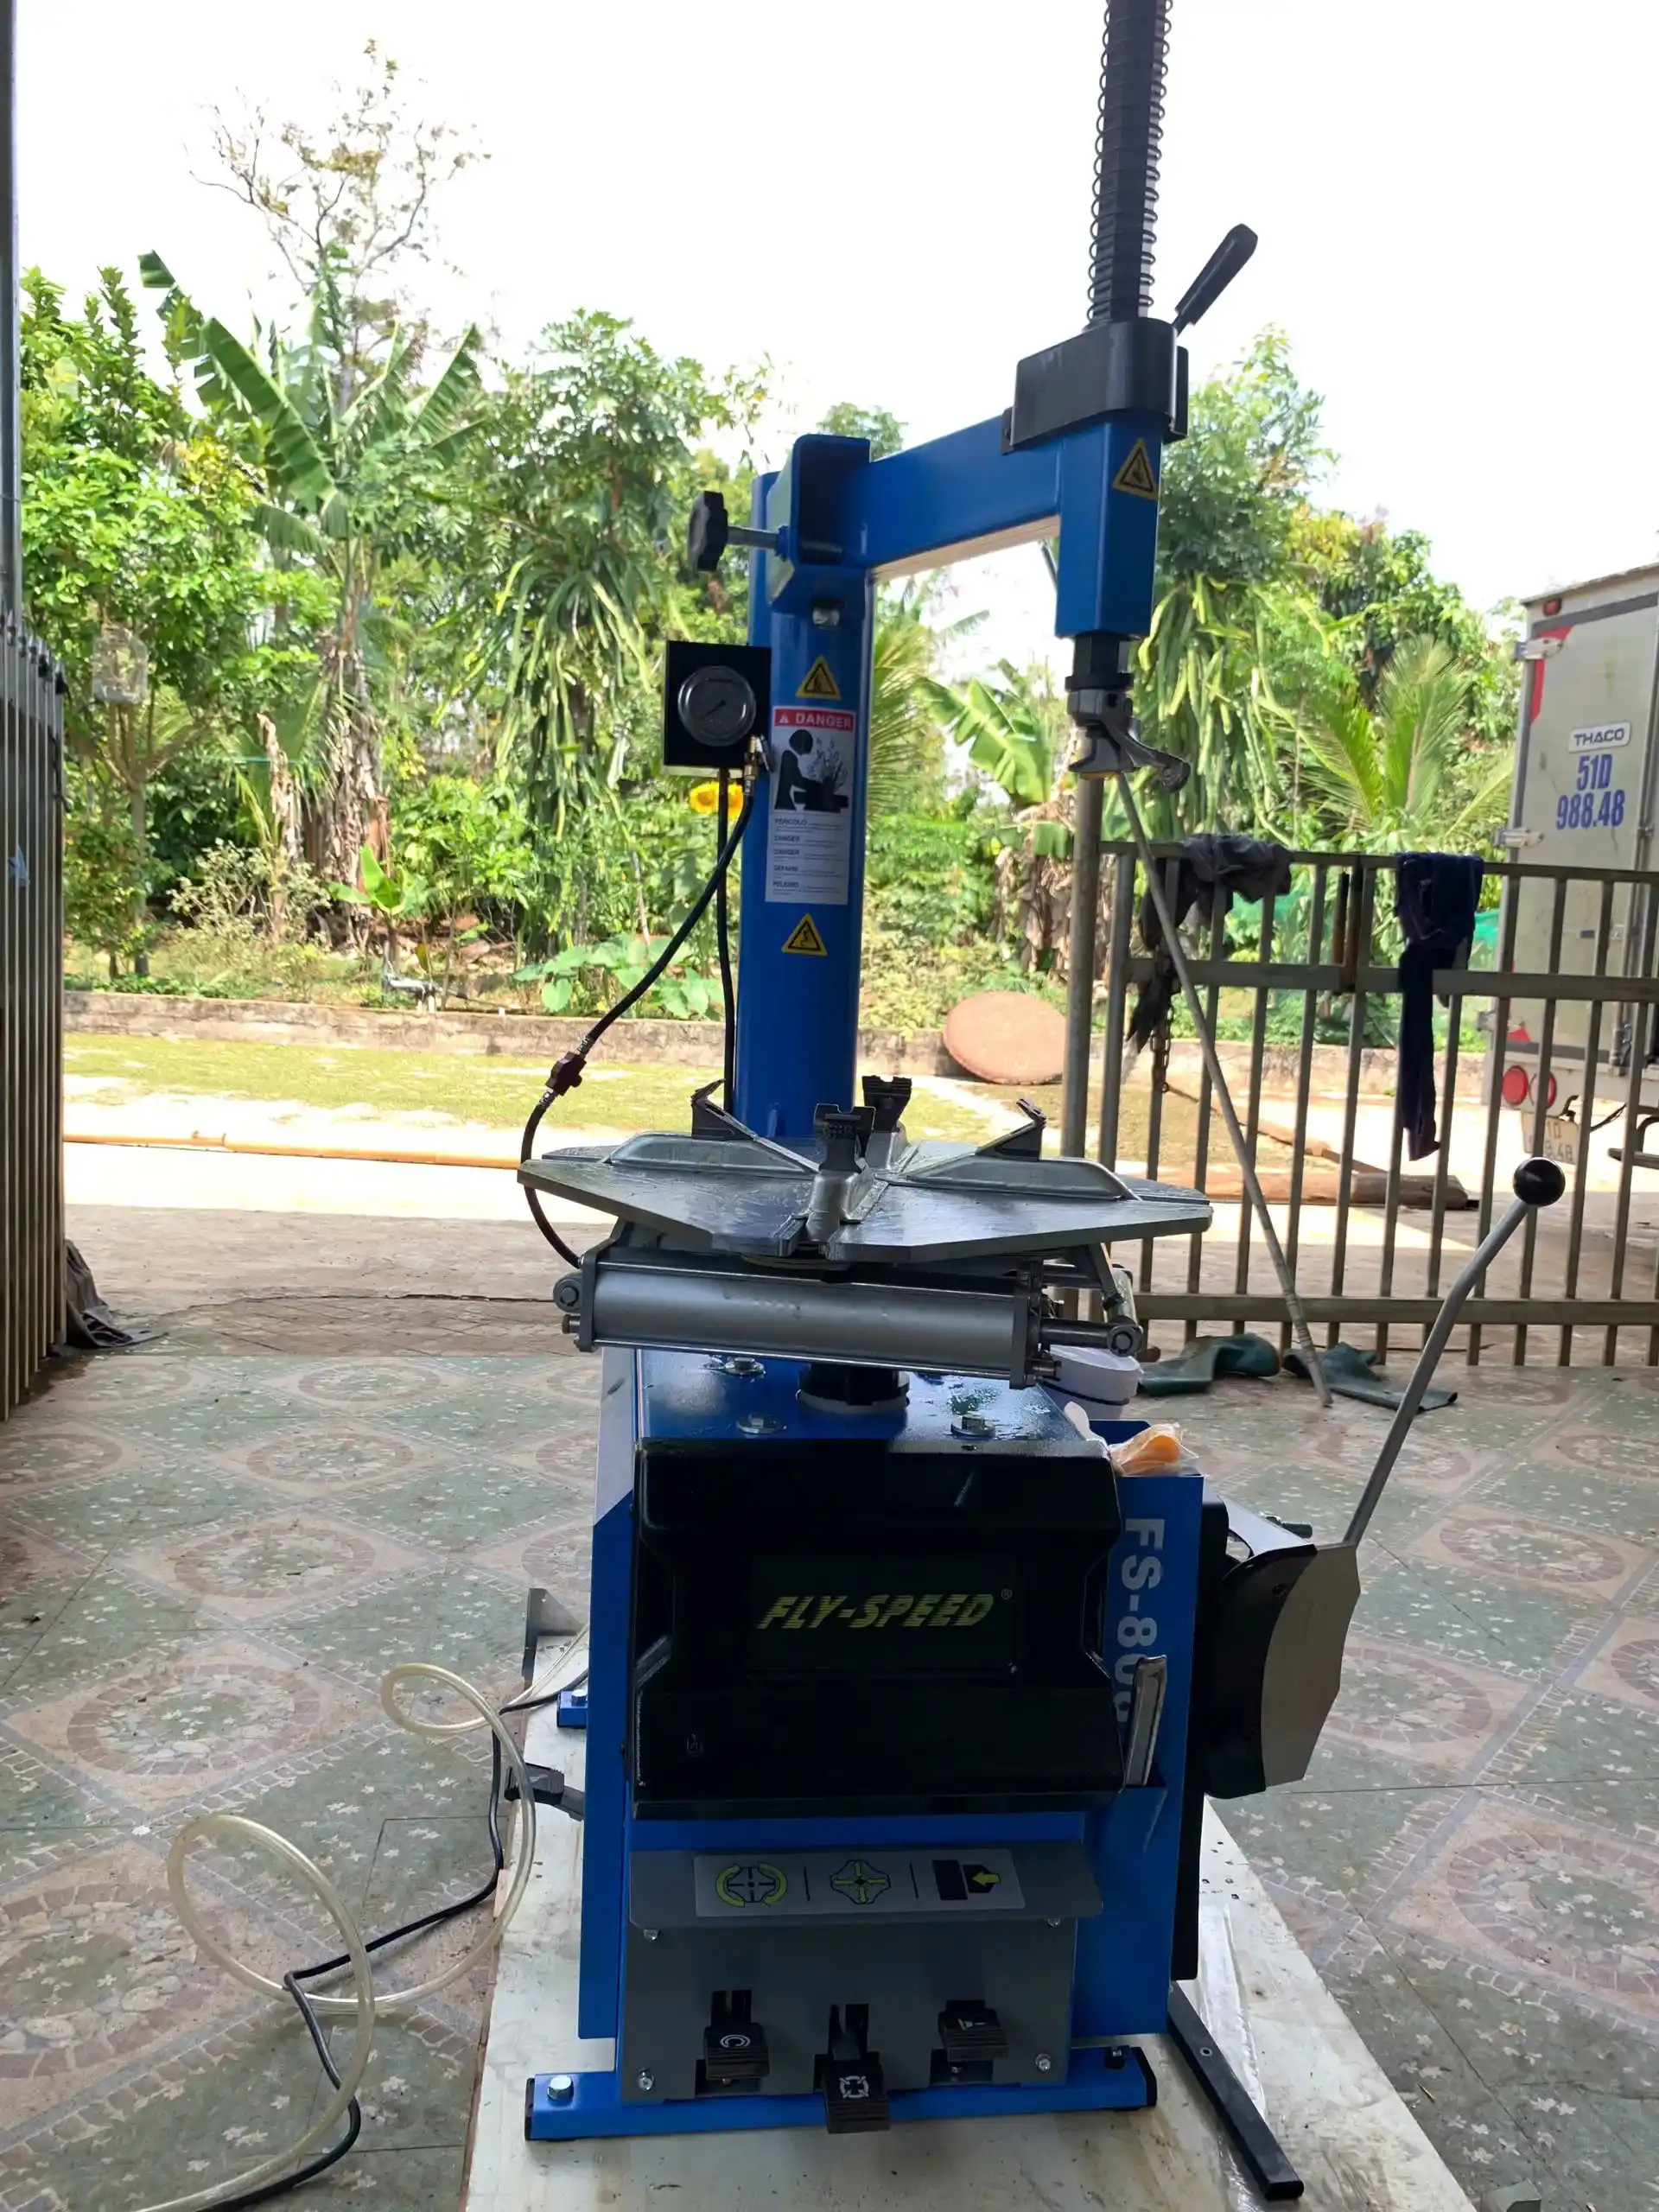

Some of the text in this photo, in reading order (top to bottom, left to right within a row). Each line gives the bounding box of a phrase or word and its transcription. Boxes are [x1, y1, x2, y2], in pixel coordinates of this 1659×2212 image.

[795, 712, 851, 728] DANGER
[1574, 728, 1625, 746] THACO
[1577, 753, 1613, 791] 51D
[1556, 789, 1625, 830] 988.48
[756, 1594, 994, 1629] FLY-SPEED
